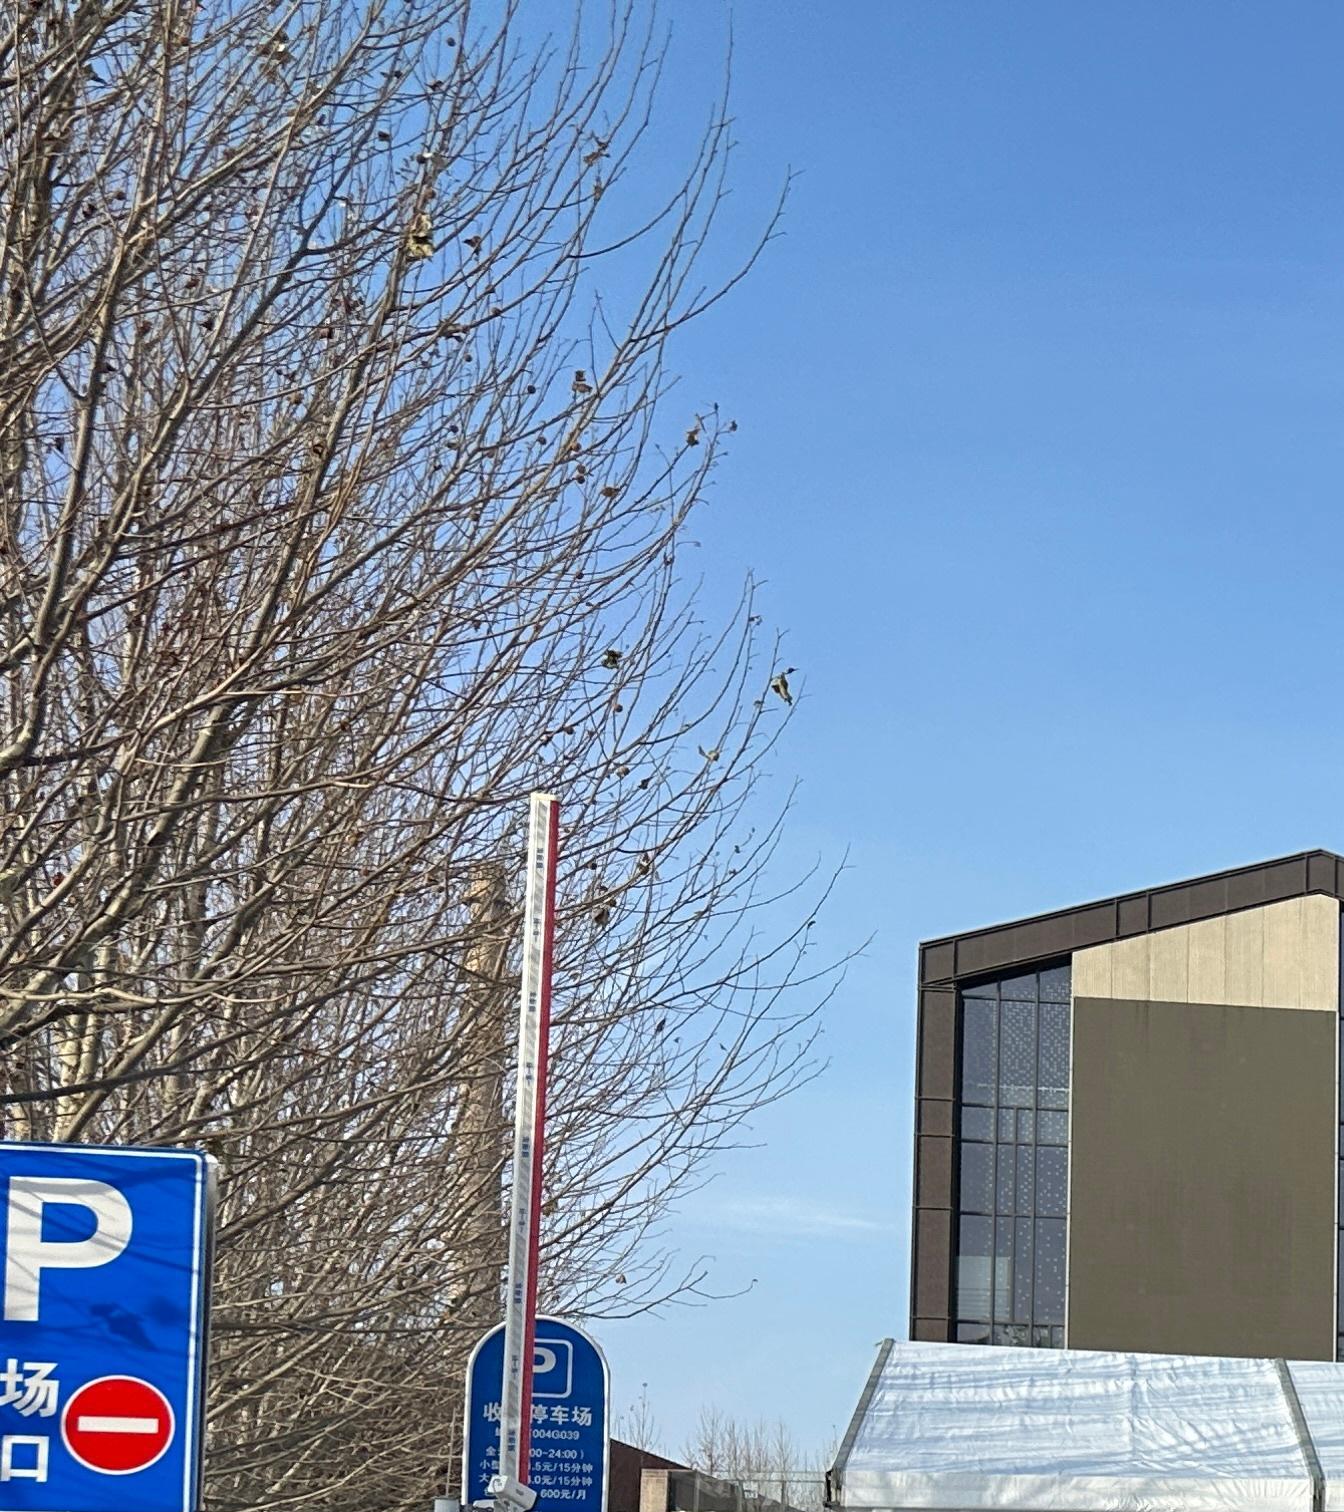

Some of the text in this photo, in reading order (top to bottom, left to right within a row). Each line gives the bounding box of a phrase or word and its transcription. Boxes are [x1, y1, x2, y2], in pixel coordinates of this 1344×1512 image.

[4, 1176, 132, 1321] P
[0, 1358, 60, 1418] 场
[483, 1402, 592, 1426] 收停车场
[0, 1434, 50, 1482] 口
